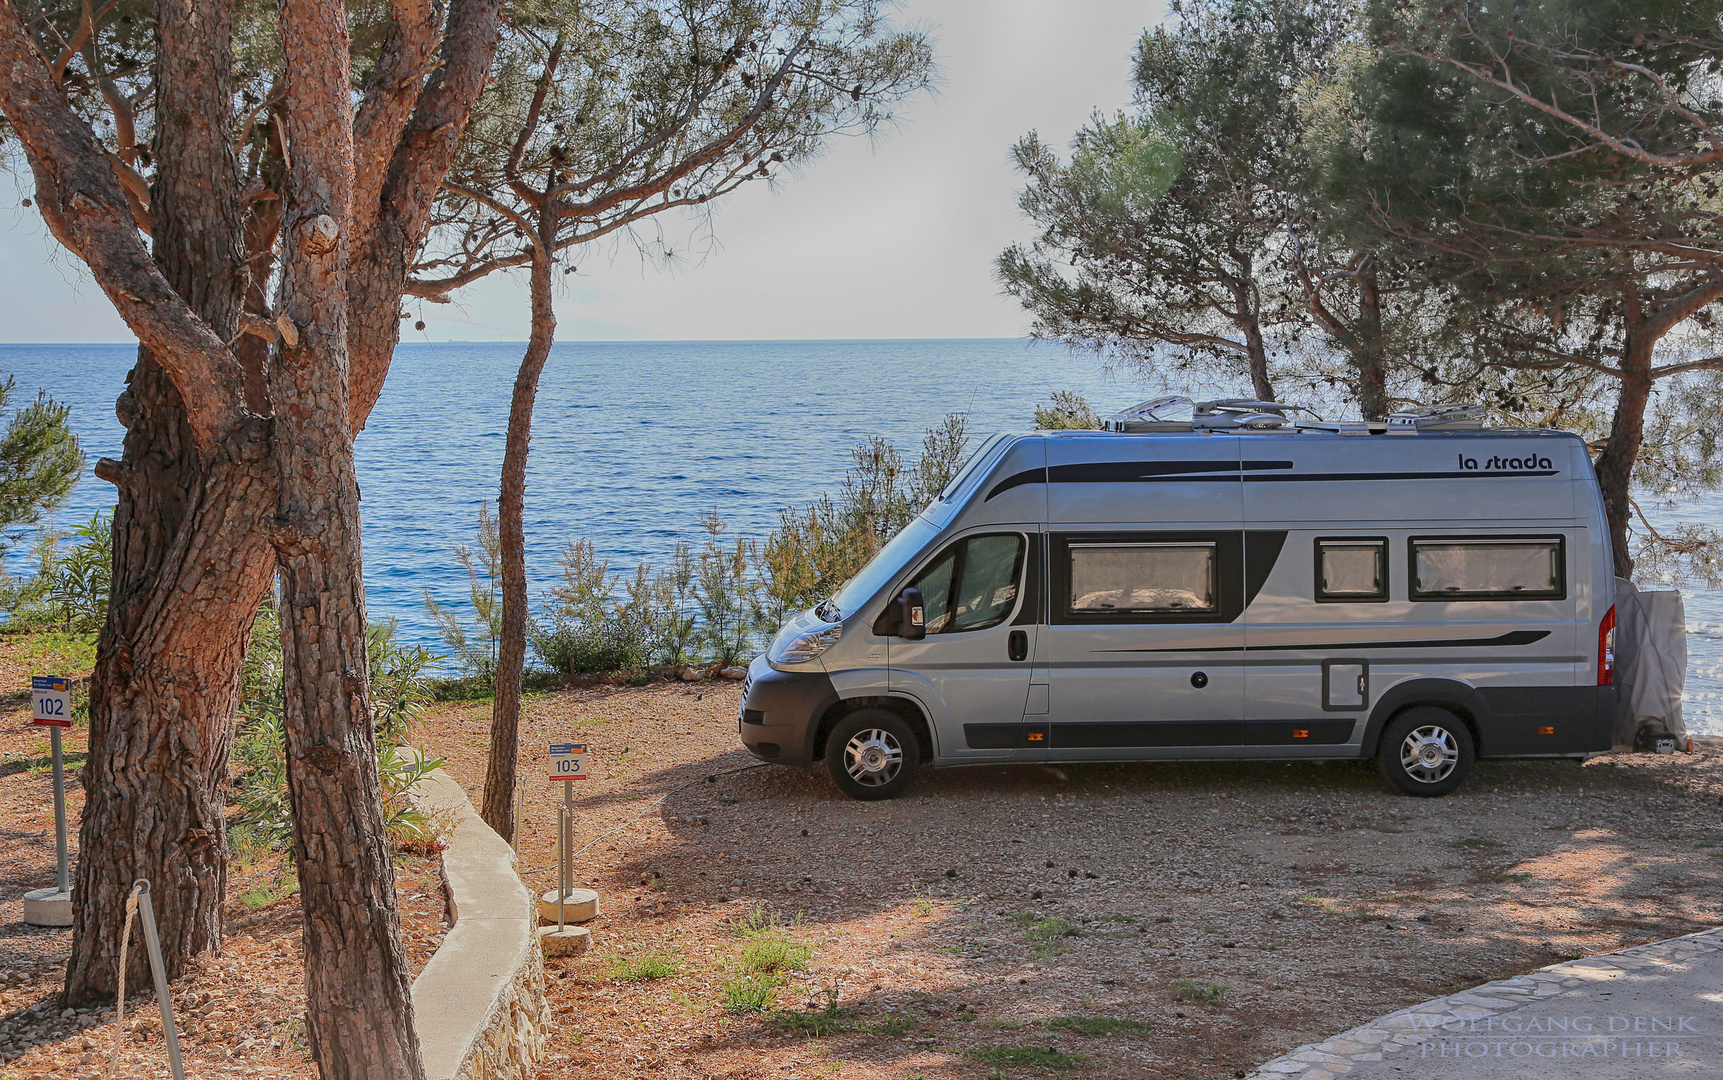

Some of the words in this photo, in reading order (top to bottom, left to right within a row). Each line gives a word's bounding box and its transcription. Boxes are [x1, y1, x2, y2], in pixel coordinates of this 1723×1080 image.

[1458, 453, 1478, 469] la
[1485, 453, 1552, 469] strada
[39, 698, 64, 715] 102
[556, 759, 580, 772] 103
